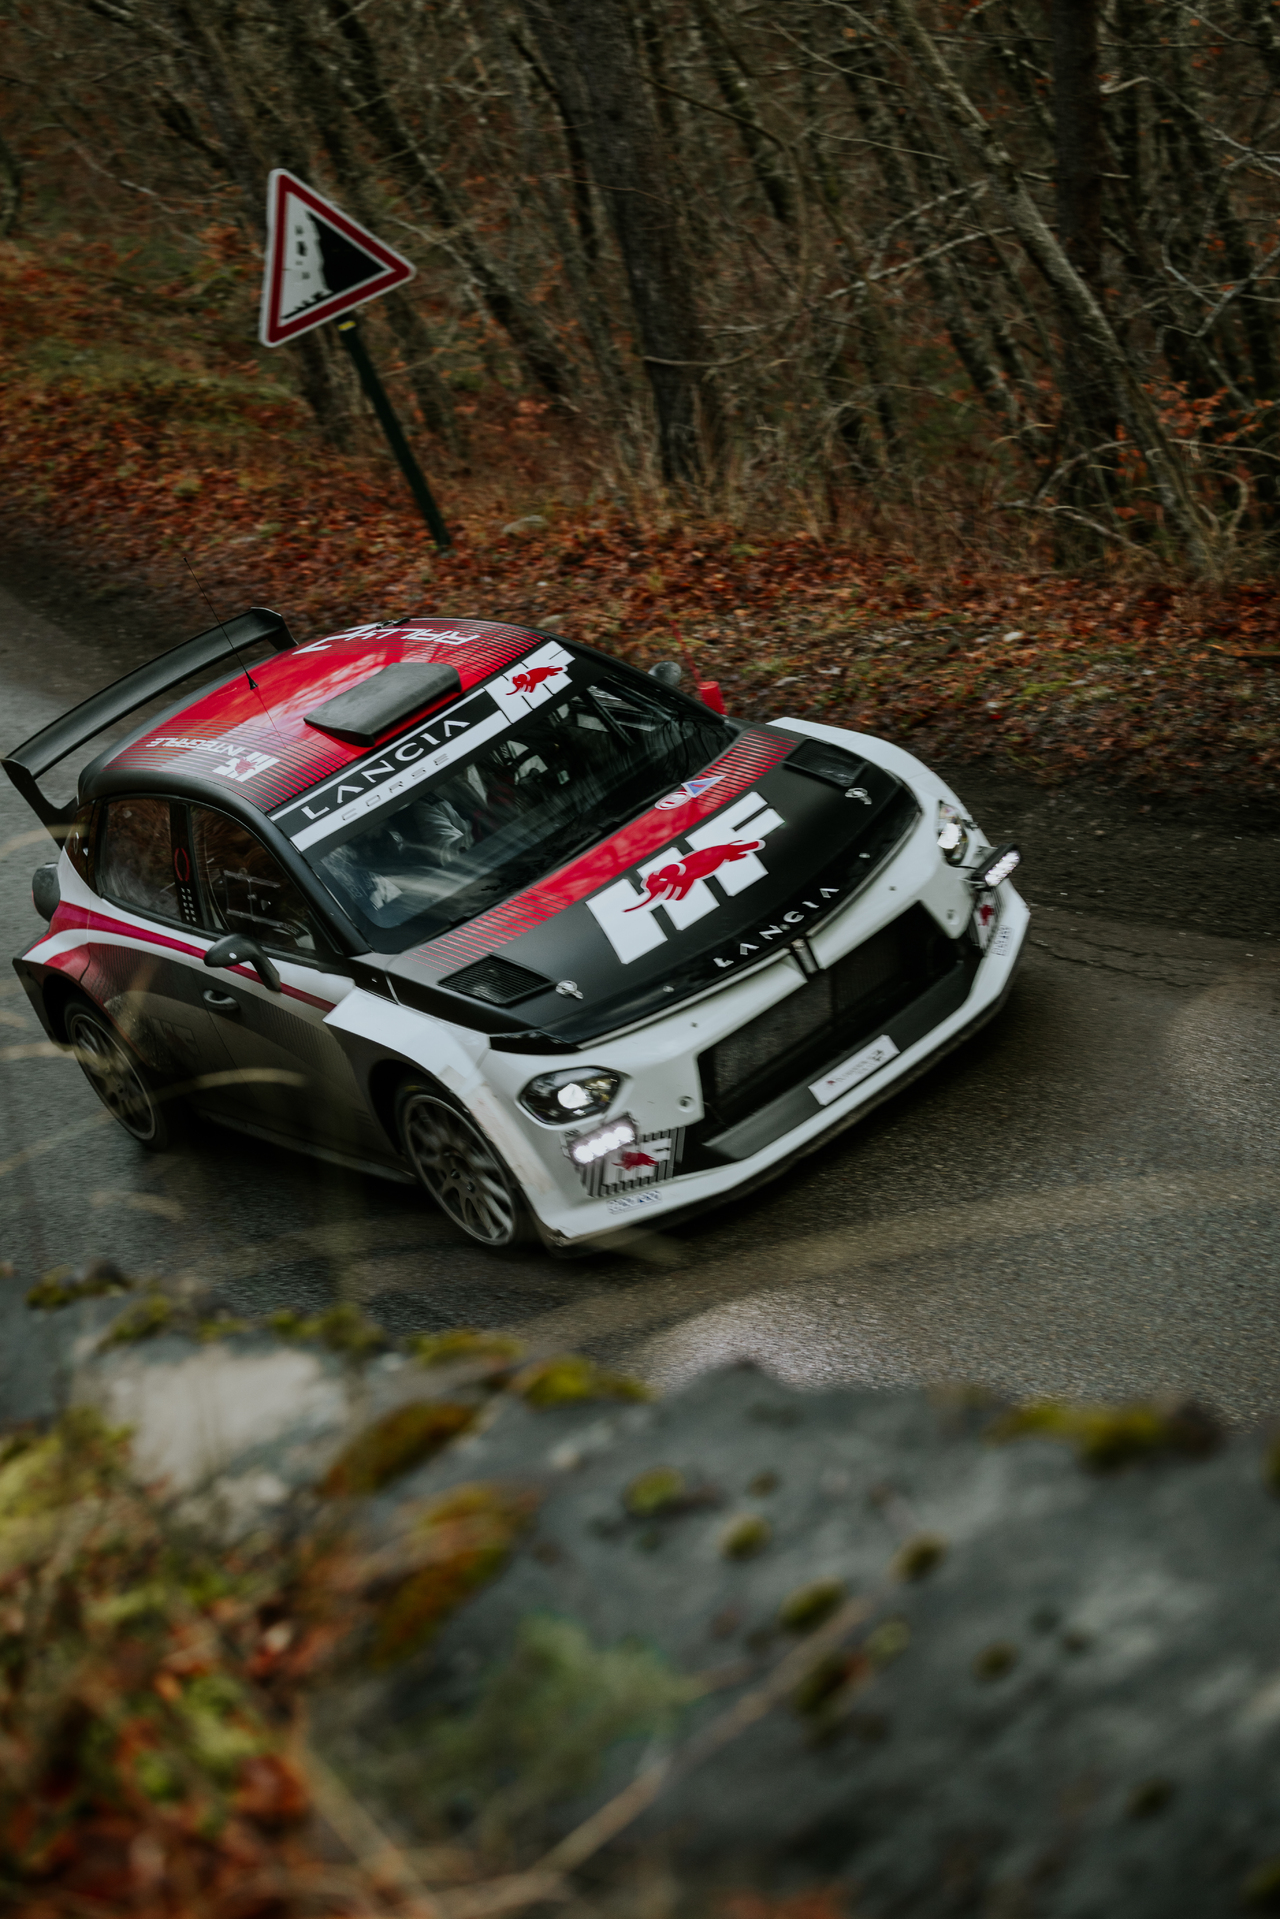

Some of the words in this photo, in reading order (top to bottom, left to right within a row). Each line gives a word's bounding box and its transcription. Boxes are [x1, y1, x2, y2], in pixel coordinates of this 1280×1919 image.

[301, 719, 471, 820] LANCIA
[341, 753, 450, 821] CORSE
[713, 887, 840, 968] LANCIA
